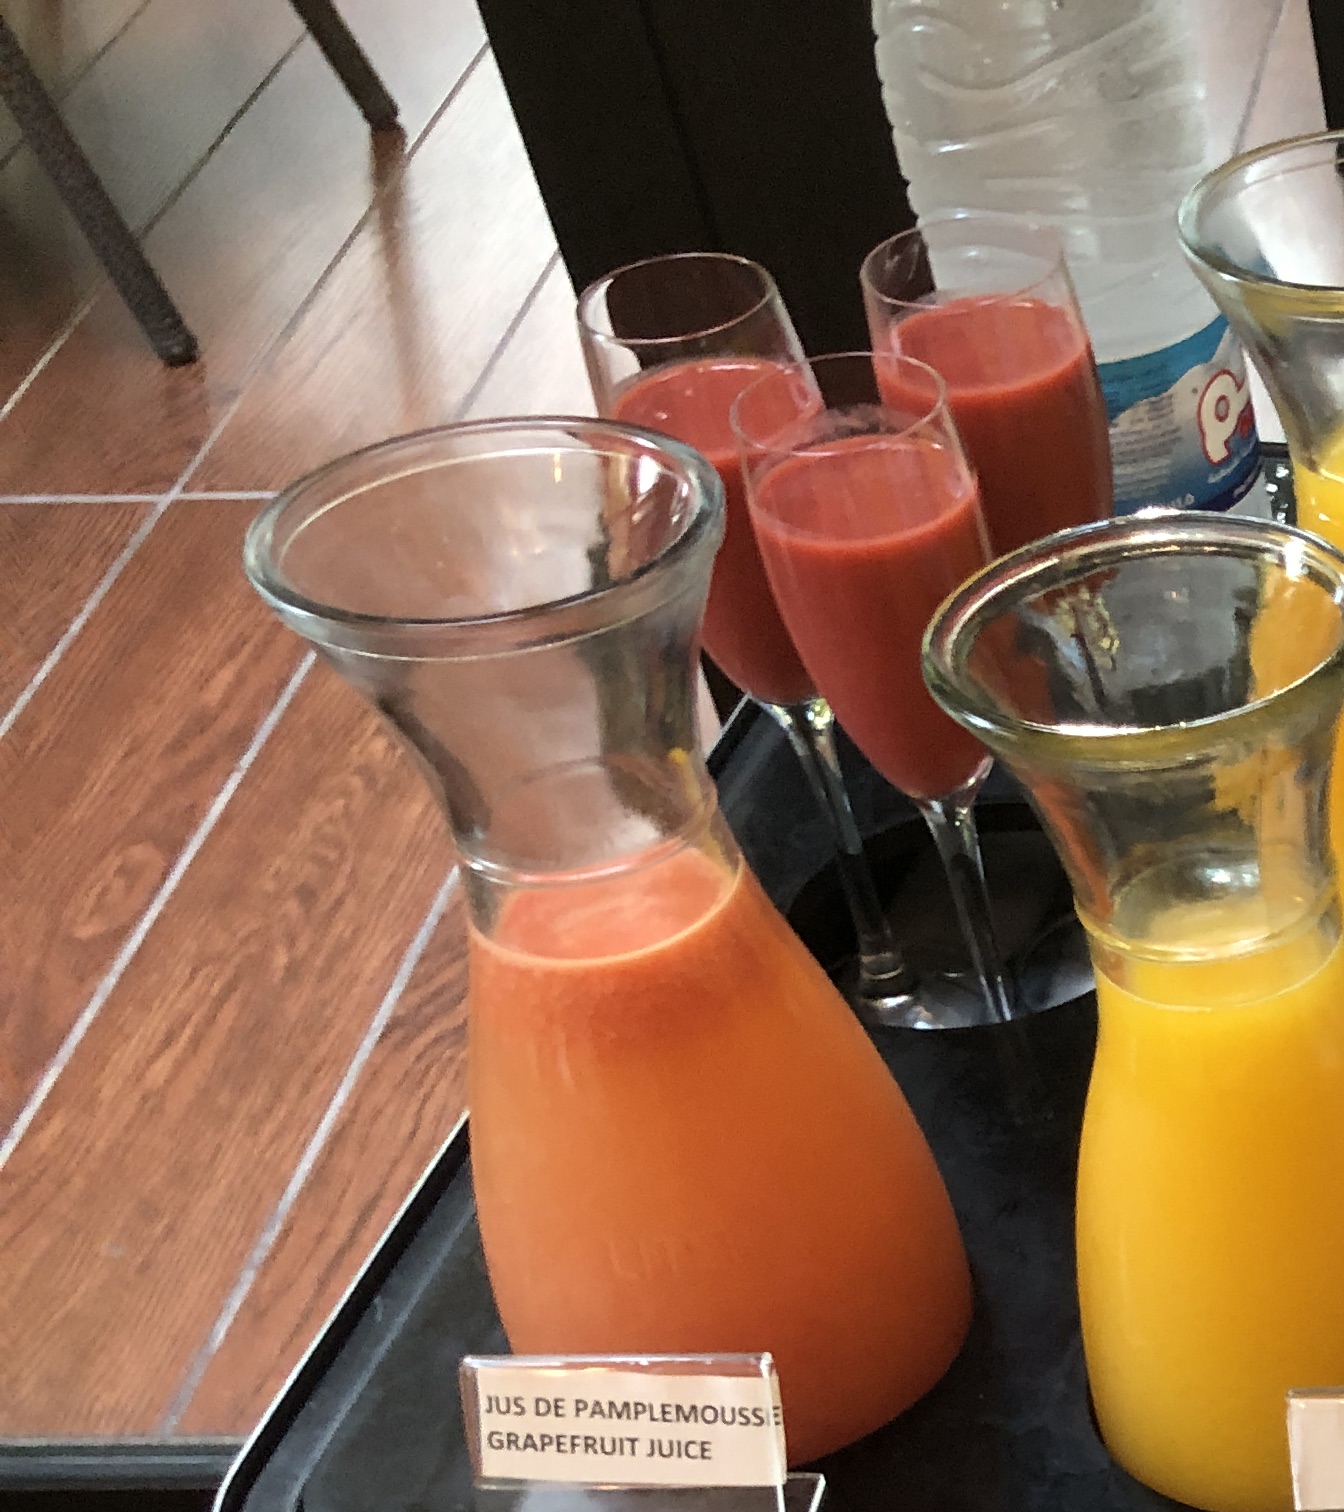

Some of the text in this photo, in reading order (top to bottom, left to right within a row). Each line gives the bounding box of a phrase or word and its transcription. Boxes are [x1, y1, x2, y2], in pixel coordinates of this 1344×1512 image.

[485, 1395, 782, 1428] JUS DE PAMPLEMOUSSE
[487, 1430, 714, 1461] GRAPEFRUIT JUICE
